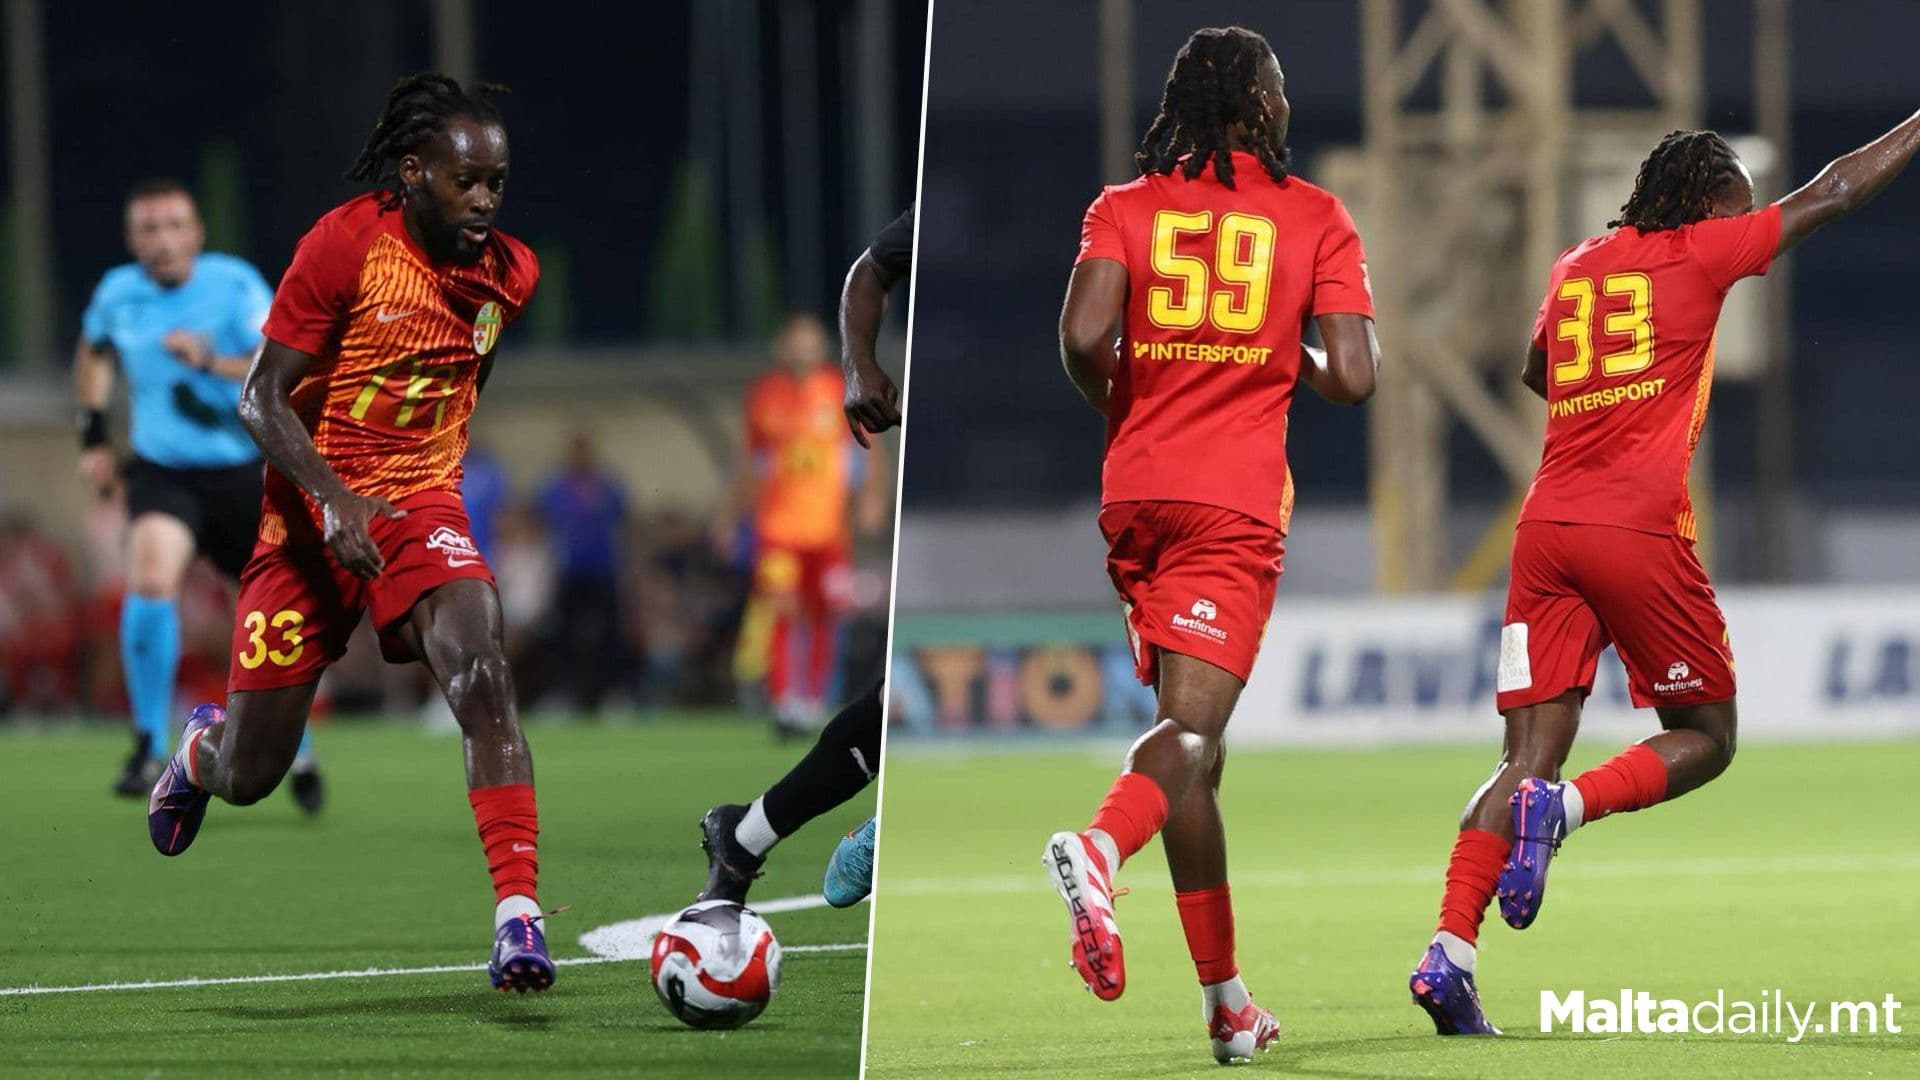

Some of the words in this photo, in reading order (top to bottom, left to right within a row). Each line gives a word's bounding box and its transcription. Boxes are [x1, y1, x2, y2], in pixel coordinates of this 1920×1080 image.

[1148, 209, 1277, 334] 59
[1151, 343, 1272, 366] INTERSPORT
[1554, 272, 1655, 387] 33
[1558, 379, 1666, 418] INTERSPORT
[239, 610, 304, 669] 33
[1172, 613, 1228, 640] fortfitness
[1051, 839, 1117, 991] PREDATOR
